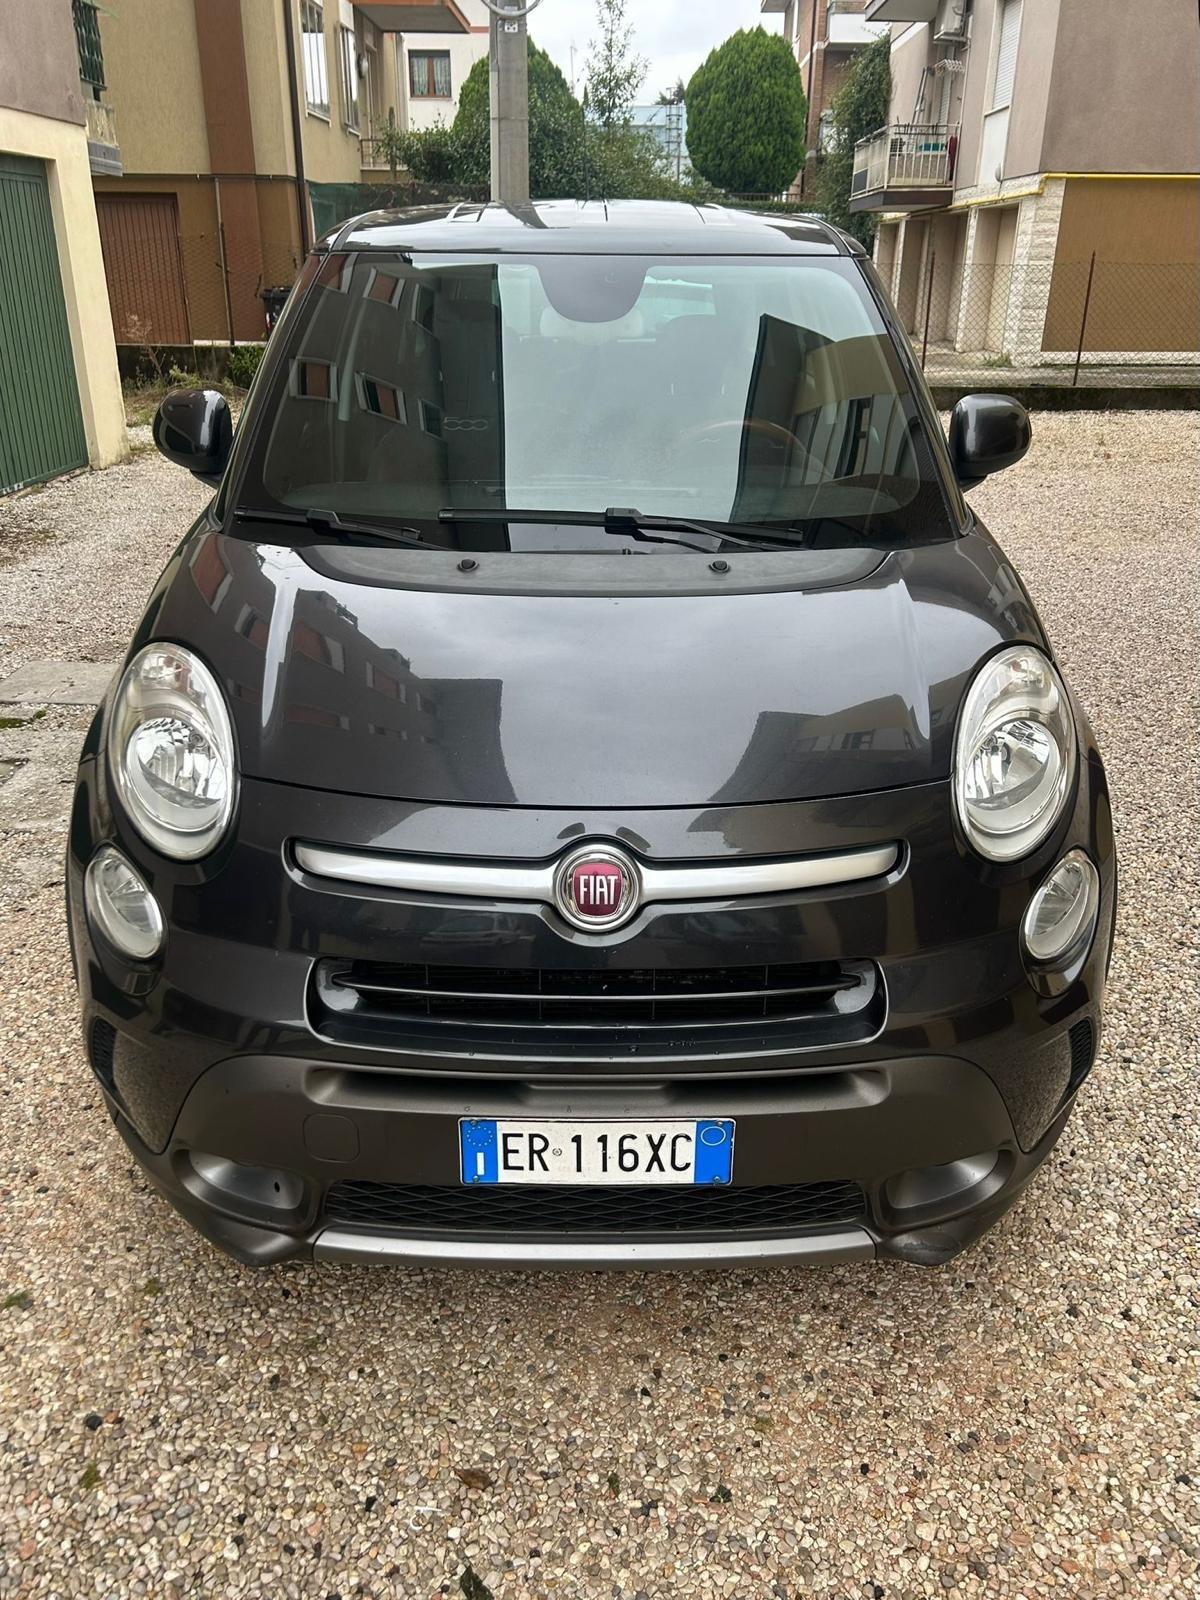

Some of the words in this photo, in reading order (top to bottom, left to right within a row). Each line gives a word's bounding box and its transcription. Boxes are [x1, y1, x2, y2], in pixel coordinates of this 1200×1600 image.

[443, 416, 488, 431] 500
[579, 875, 618, 905] FIAT
[476, 1152, 485, 1175] I
[502, 1132, 550, 1172] ER
[571, 1133, 692, 1173] 116XC
